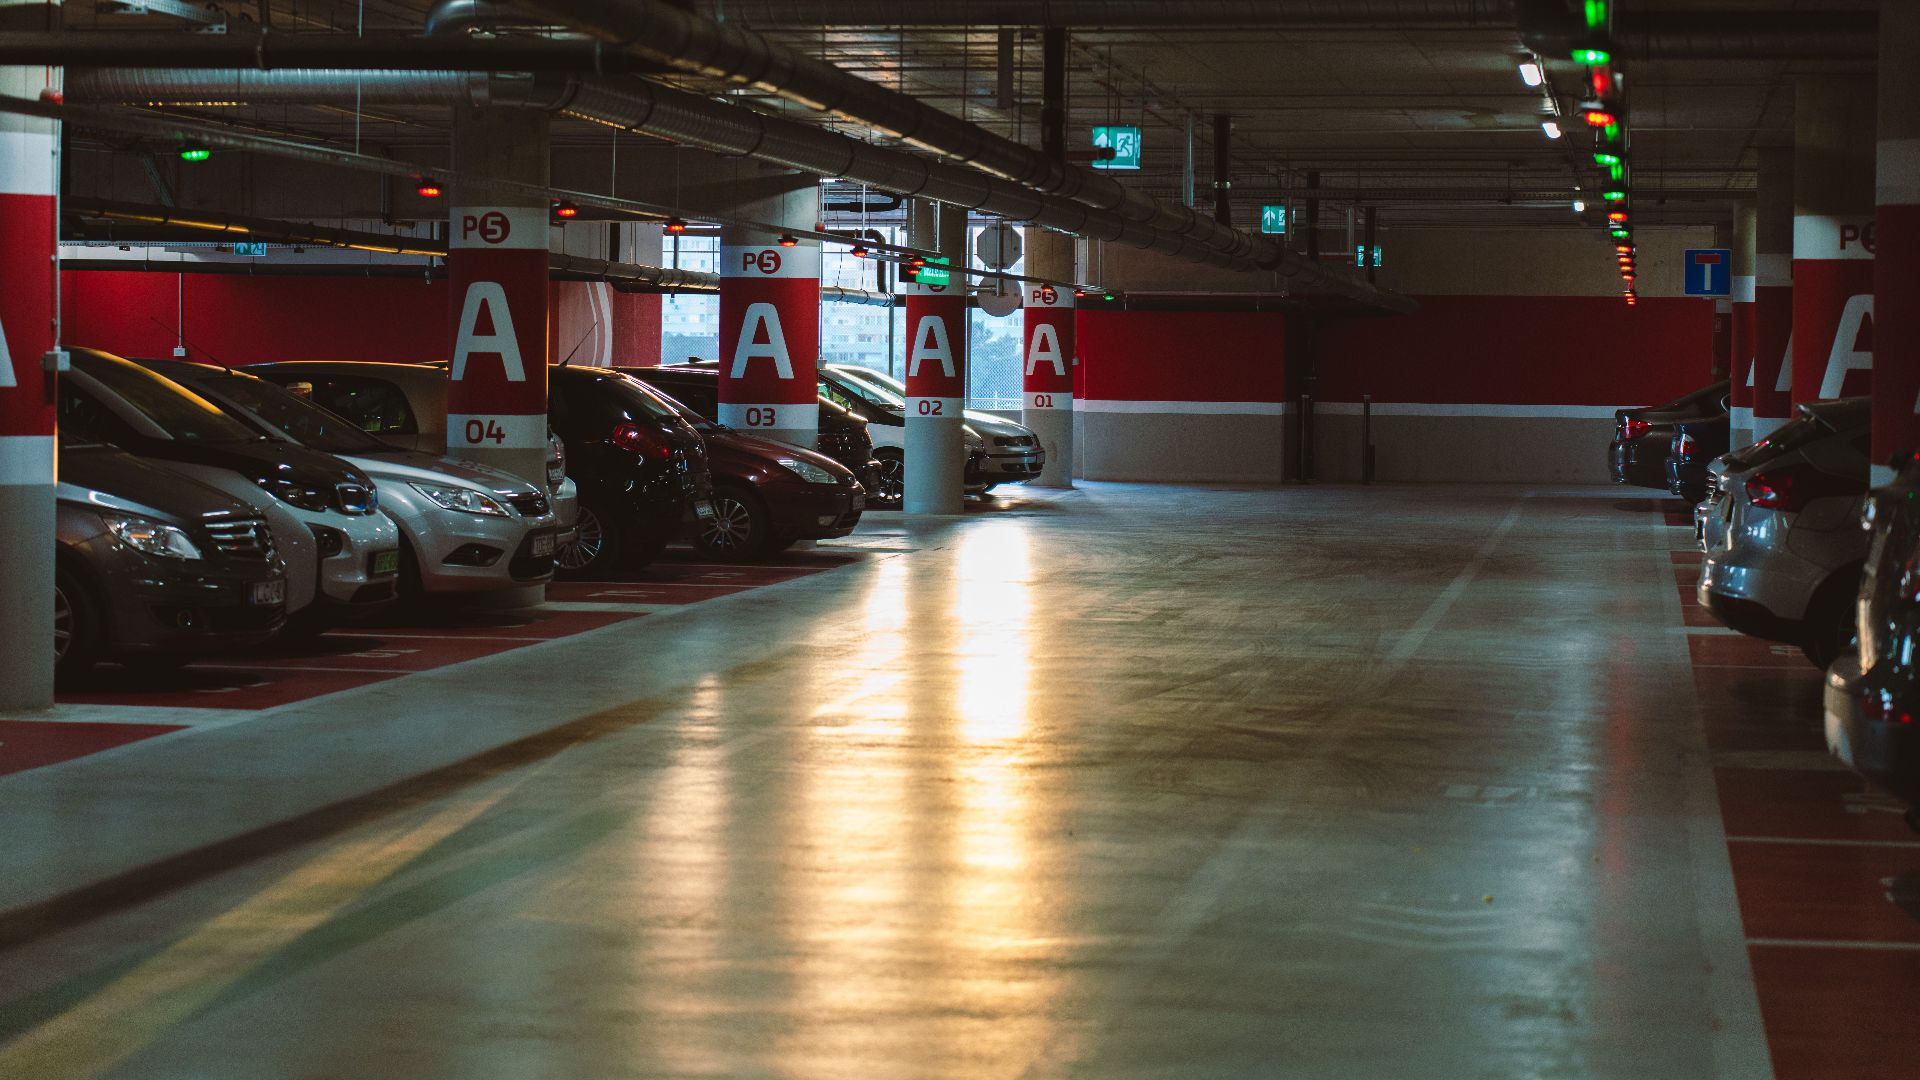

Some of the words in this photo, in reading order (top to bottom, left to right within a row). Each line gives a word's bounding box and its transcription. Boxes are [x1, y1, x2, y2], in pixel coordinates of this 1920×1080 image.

[462, 213, 511, 244] P5
[742, 249, 782, 275] P5
[1032, 287, 1058, 305] P5
[451, 281, 526, 382] A
[730, 303, 795, 379] A
[909, 316, 955, 378] A
[1026, 324, 1065, 376] A
[1818, 294, 1874, 399] A
[918, 400, 942, 416] 02
[1034, 394, 1053, 408] 01
[746, 408, 776, 427] 03
[465, 420, 505, 445] 04
